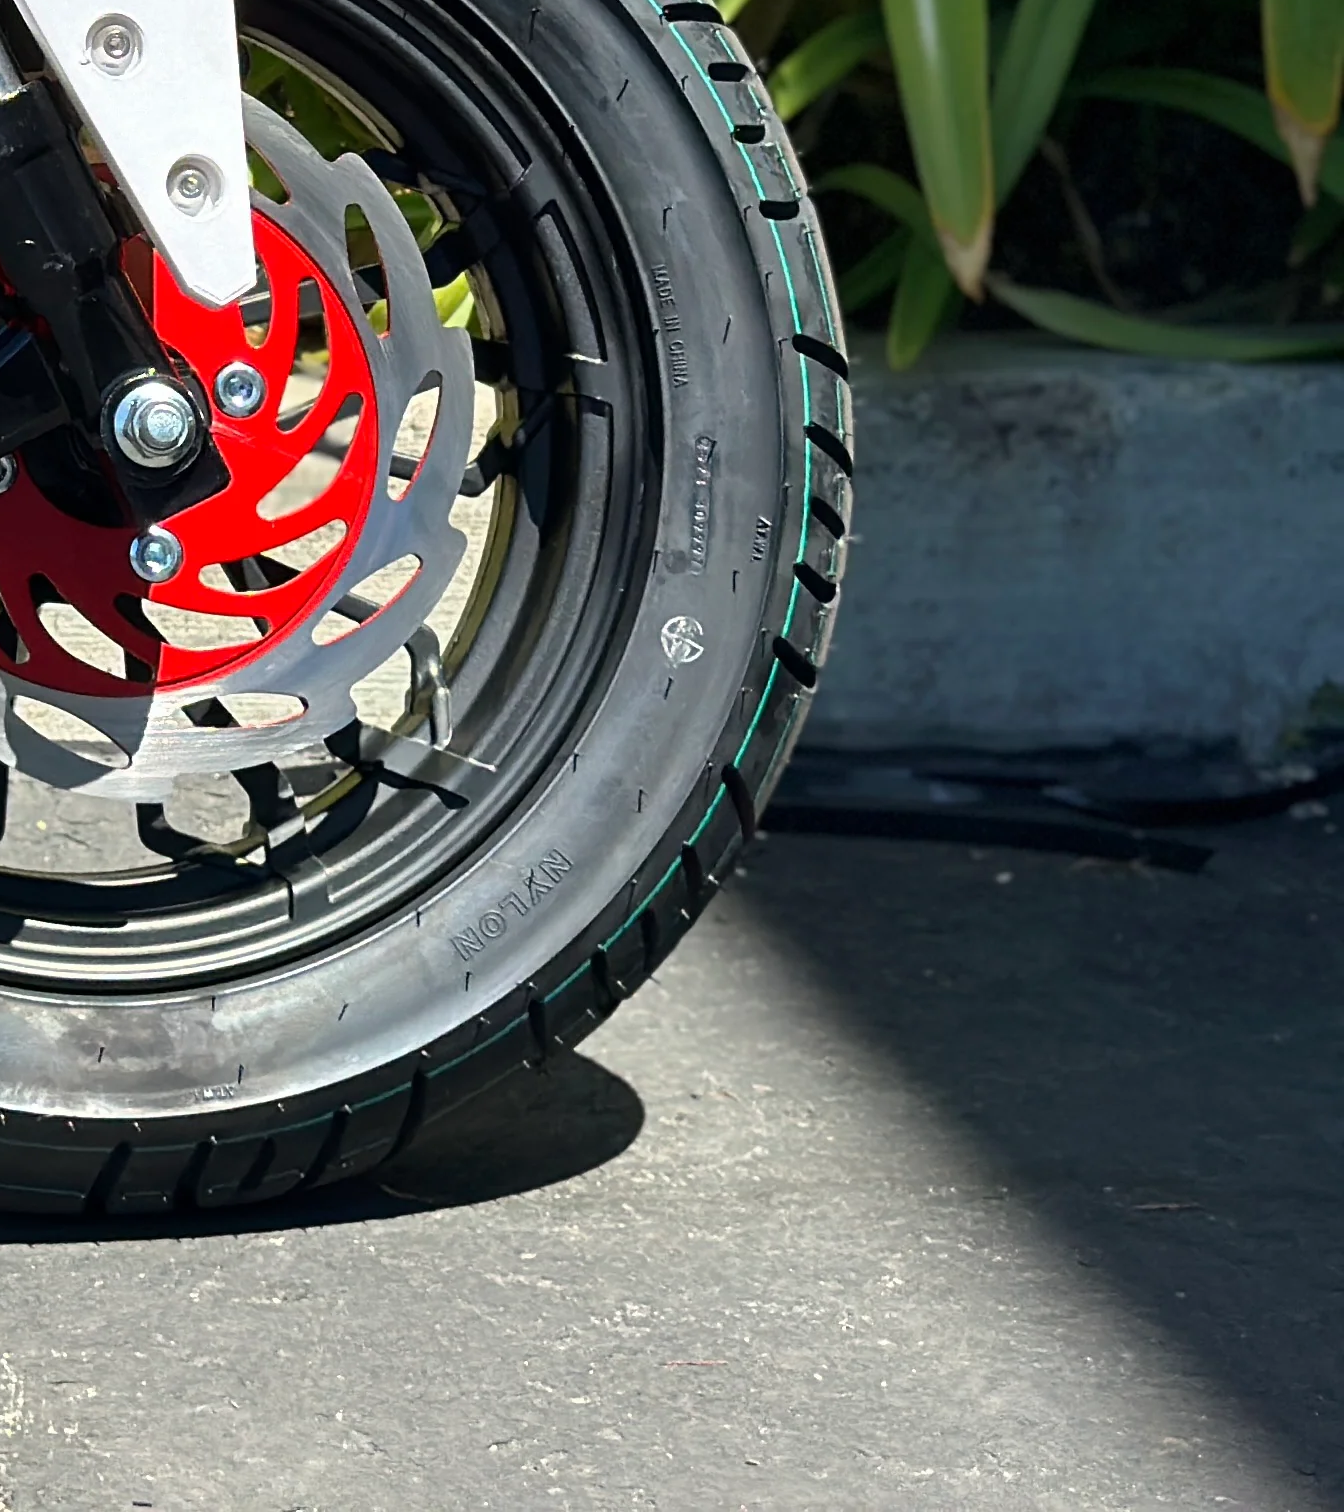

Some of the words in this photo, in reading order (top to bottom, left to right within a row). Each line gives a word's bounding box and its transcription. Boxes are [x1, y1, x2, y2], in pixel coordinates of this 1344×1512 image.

[651, 264, 676, 309] MADE
[663, 315, 681, 333] IN
[669, 339, 689, 389] CHINA
[451, 848, 574, 962] NYLON
